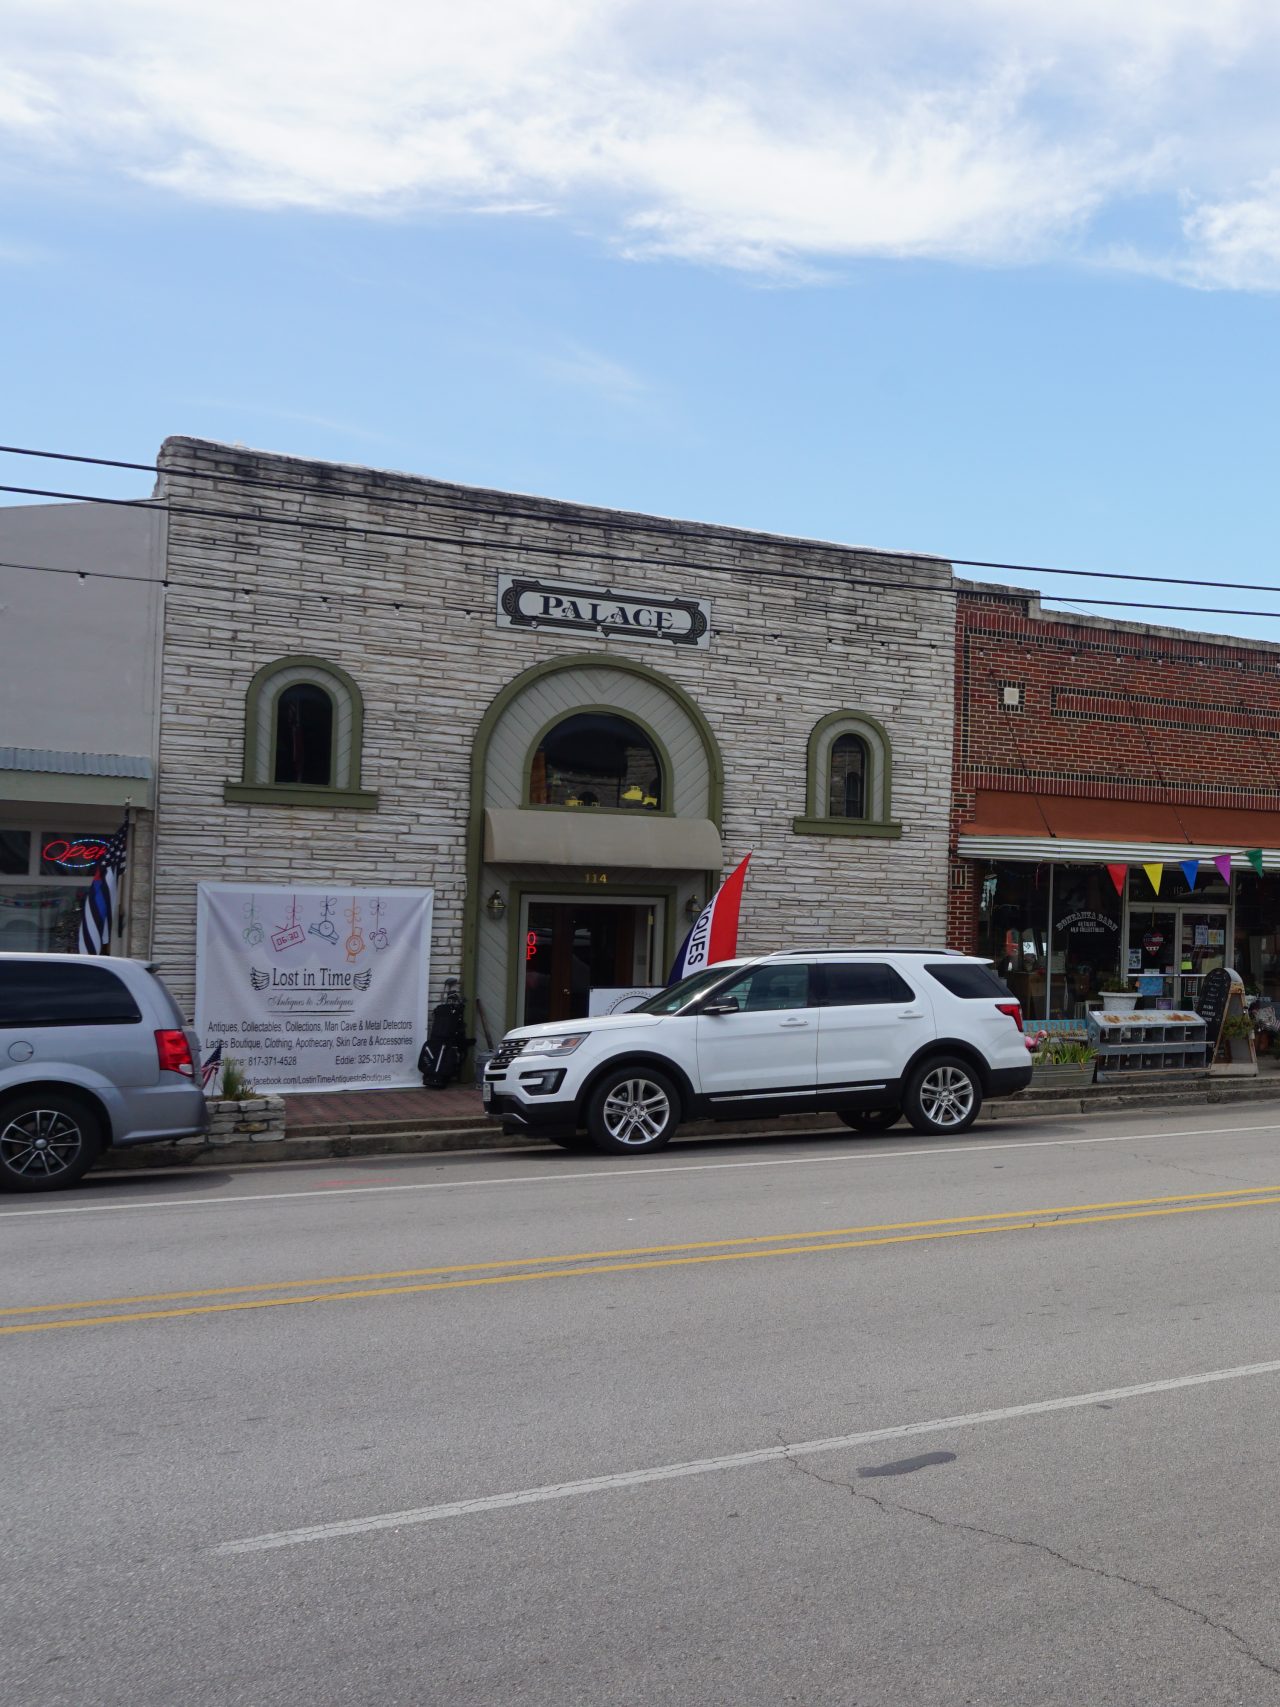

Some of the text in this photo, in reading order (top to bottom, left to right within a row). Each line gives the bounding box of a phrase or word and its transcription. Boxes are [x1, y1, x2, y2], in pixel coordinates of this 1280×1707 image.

[539, 595, 674, 630] PALACE
[585, 873, 608, 884] 114
[272, 967, 351, 986] Lost in Time
[268, 993, 304, 1010] Antiques
[316, 992, 354, 1010] Boutiques
[207, 1019, 413, 1034] Antiques, Collectables, Collections, Man Cave & Metal Detectors
[230, 1037, 263, 1051] Boutique,
[296, 1037, 335, 1050] Apothecary,
[336, 1036, 351, 1048] Skin
[352, 1036, 368, 1047] Care
[368, 1035, 374, 1046] &
[374, 1035, 413, 1046] Accessories
[248, 1056, 297, 1066] 817-371-4528
[335, 1055, 356, 1065] Eddie:
[241, 1073, 392, 1086] ww.facebook.com/LostinTimeAntiquestoBoutiques
